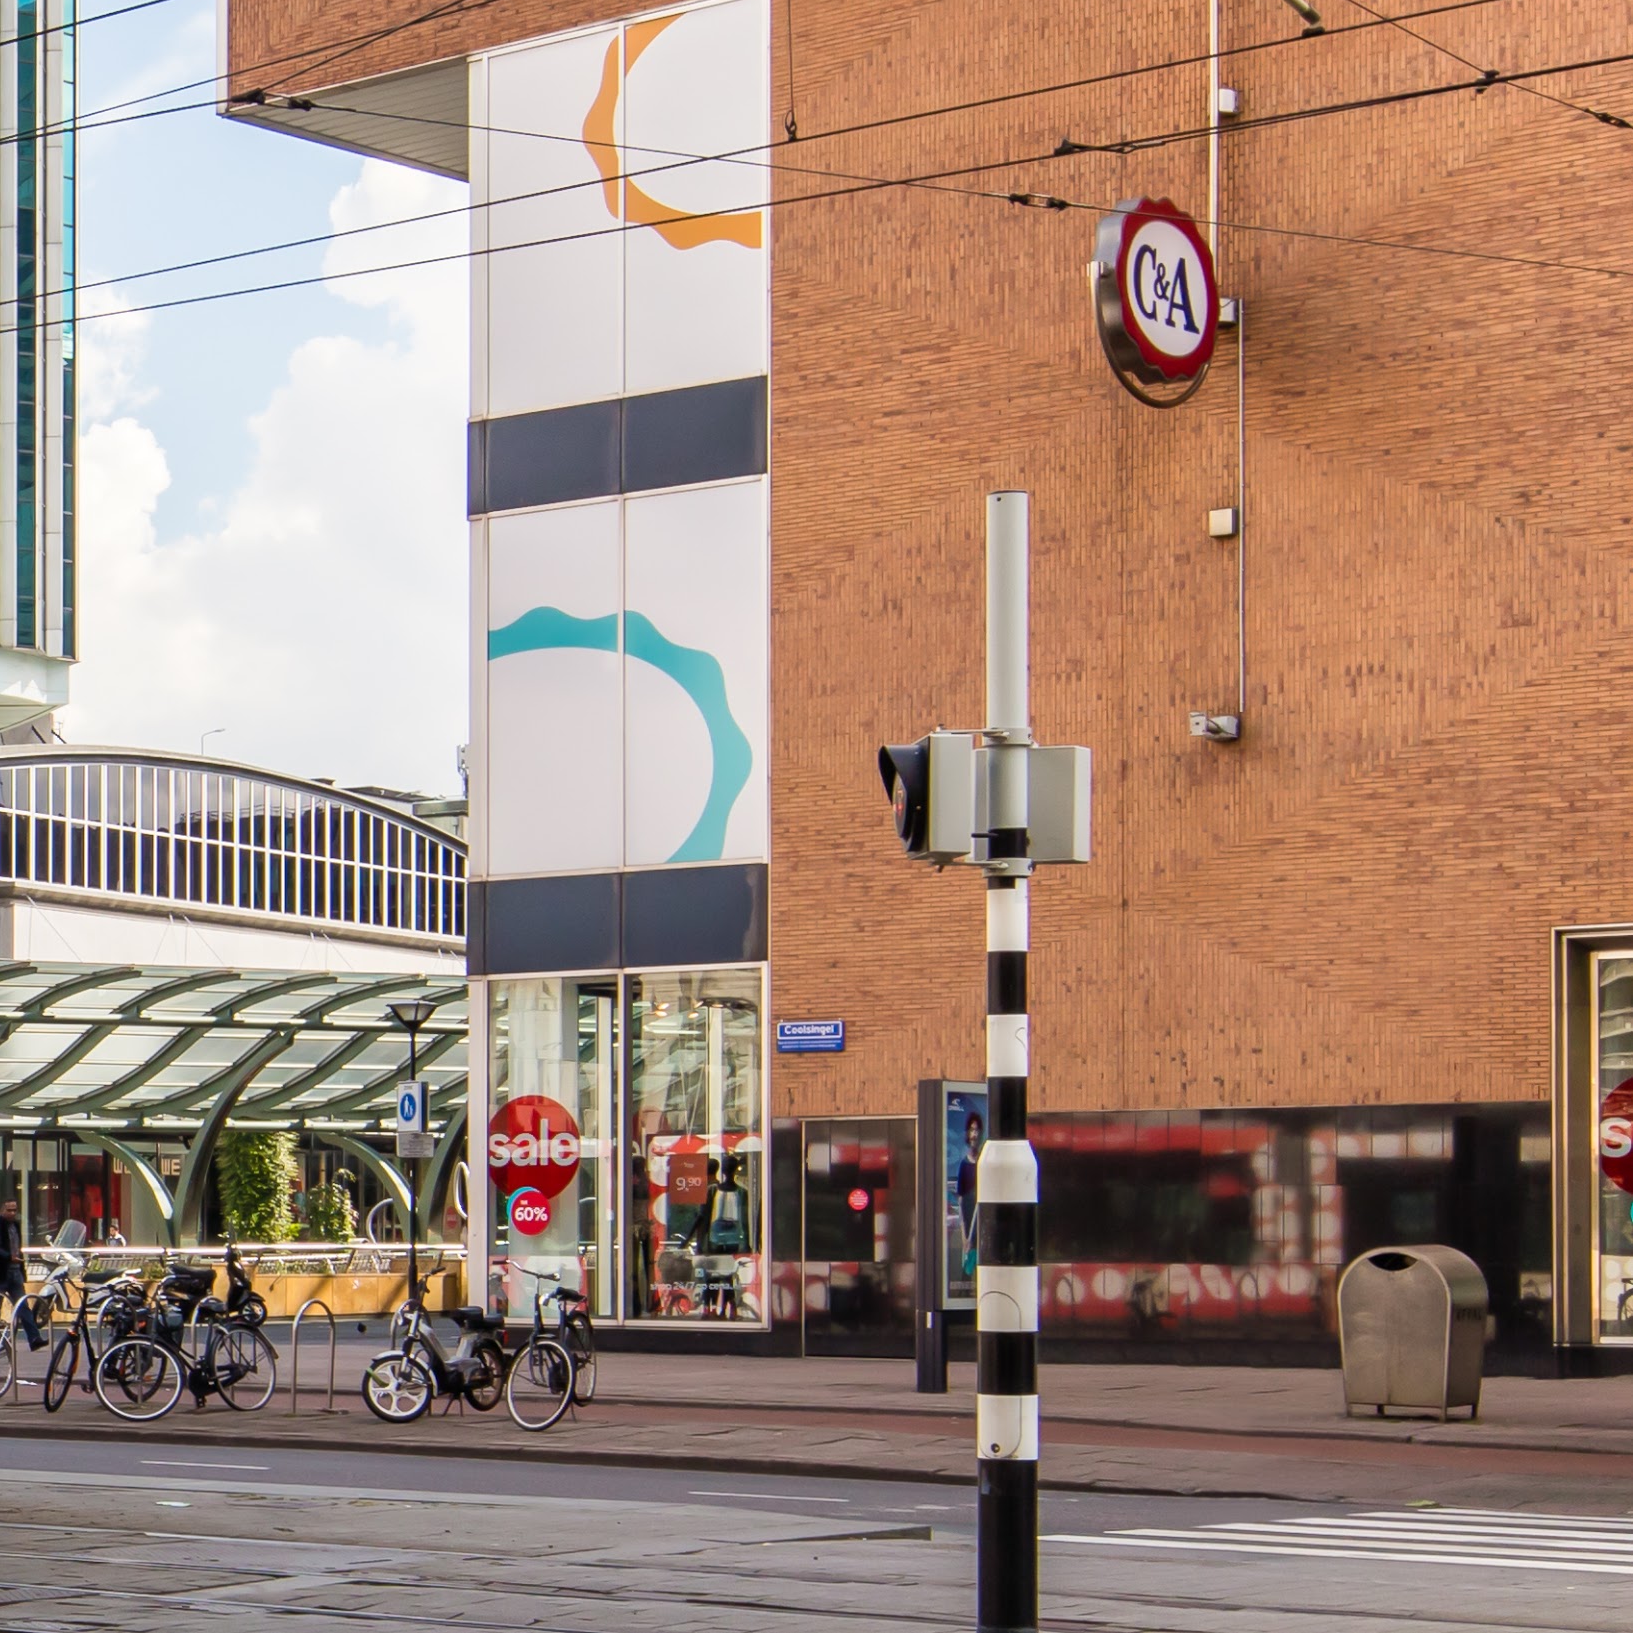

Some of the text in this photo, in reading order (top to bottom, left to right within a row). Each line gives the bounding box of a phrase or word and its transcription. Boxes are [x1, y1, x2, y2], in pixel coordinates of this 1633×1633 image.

[1133, 243, 1200, 335] C&A
[784, 1024, 835, 1036] Coolsingel
[489, 1118, 579, 1167] sale
[161, 1158, 181, 1176] WE
[514, 1206, 548, 1221] 60%
